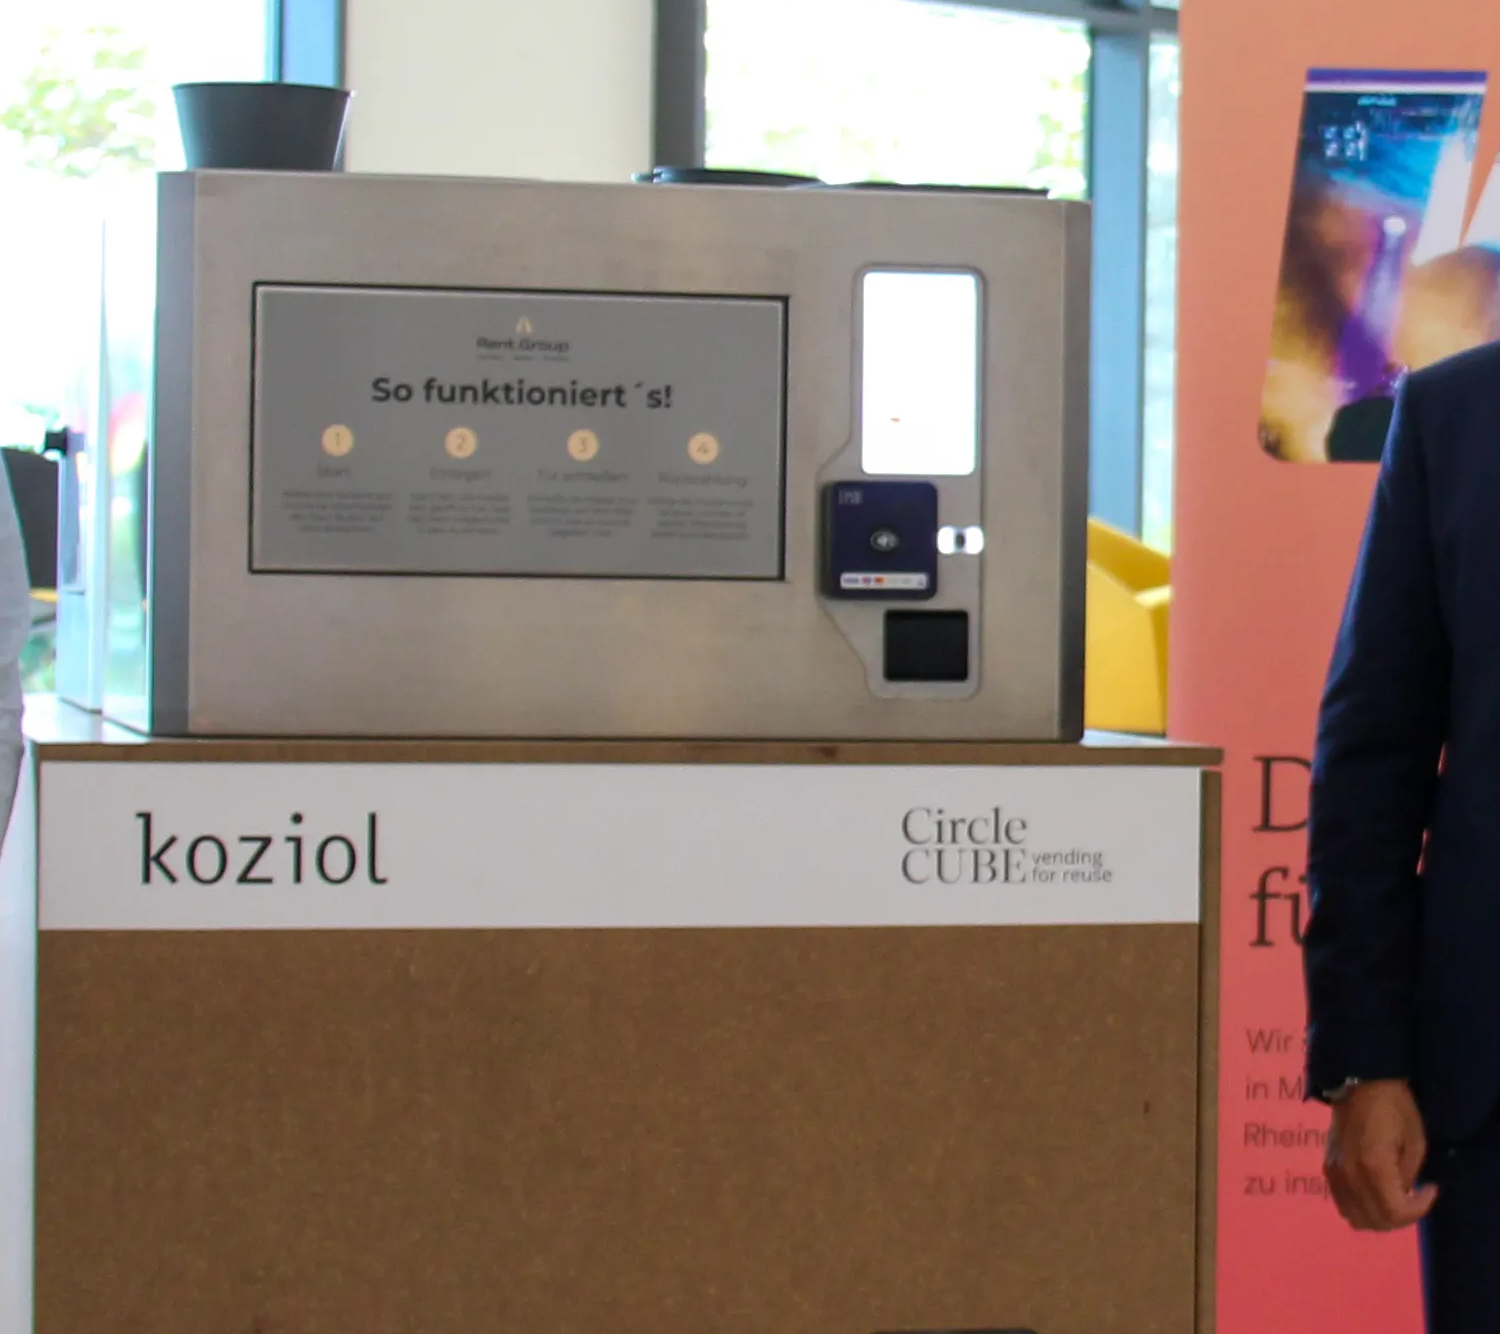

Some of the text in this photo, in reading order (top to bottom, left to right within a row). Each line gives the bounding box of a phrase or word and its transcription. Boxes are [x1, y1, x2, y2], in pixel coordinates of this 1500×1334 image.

[371, 377, 413, 403] So
[423, 377, 627, 408] funktioniert
[454, 433, 466, 452] 2
[578, 436, 589, 454] 3
[901, 805, 1028, 845] Circle
[134, 811, 388, 885] koziol
[901, 848, 1104, 885] CUBE vending
[1032, 867, 1113, 883] for reuse
[1245, 1028, 1293, 1054] Wir
[1245, 1075, 1269, 1101] in
[1243, 1175, 1276, 1196] zu
